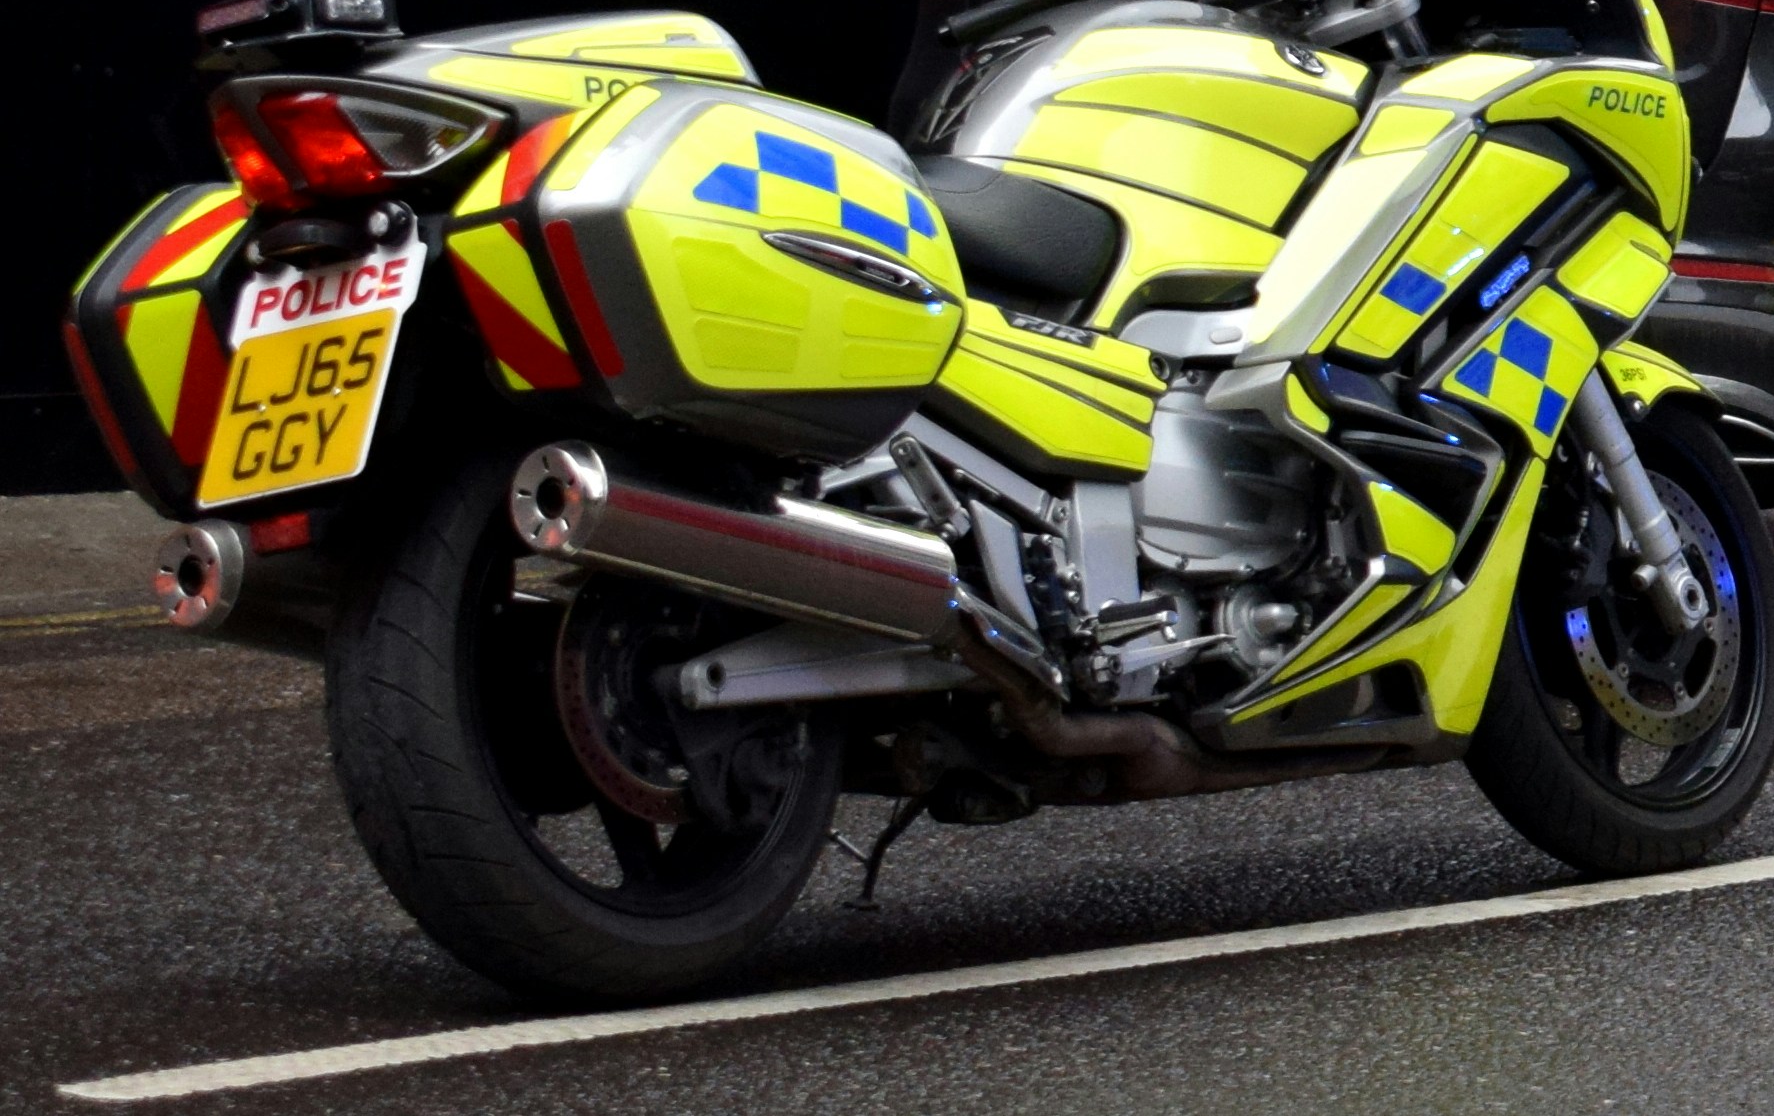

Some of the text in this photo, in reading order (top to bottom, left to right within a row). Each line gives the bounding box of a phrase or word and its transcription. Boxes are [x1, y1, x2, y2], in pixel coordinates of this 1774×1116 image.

[1588, 86, 1667, 118] POLICE
[250, 258, 408, 328] POLICE
[231, 327, 385, 416] LJ65
[232, 403, 349, 482] GGY
